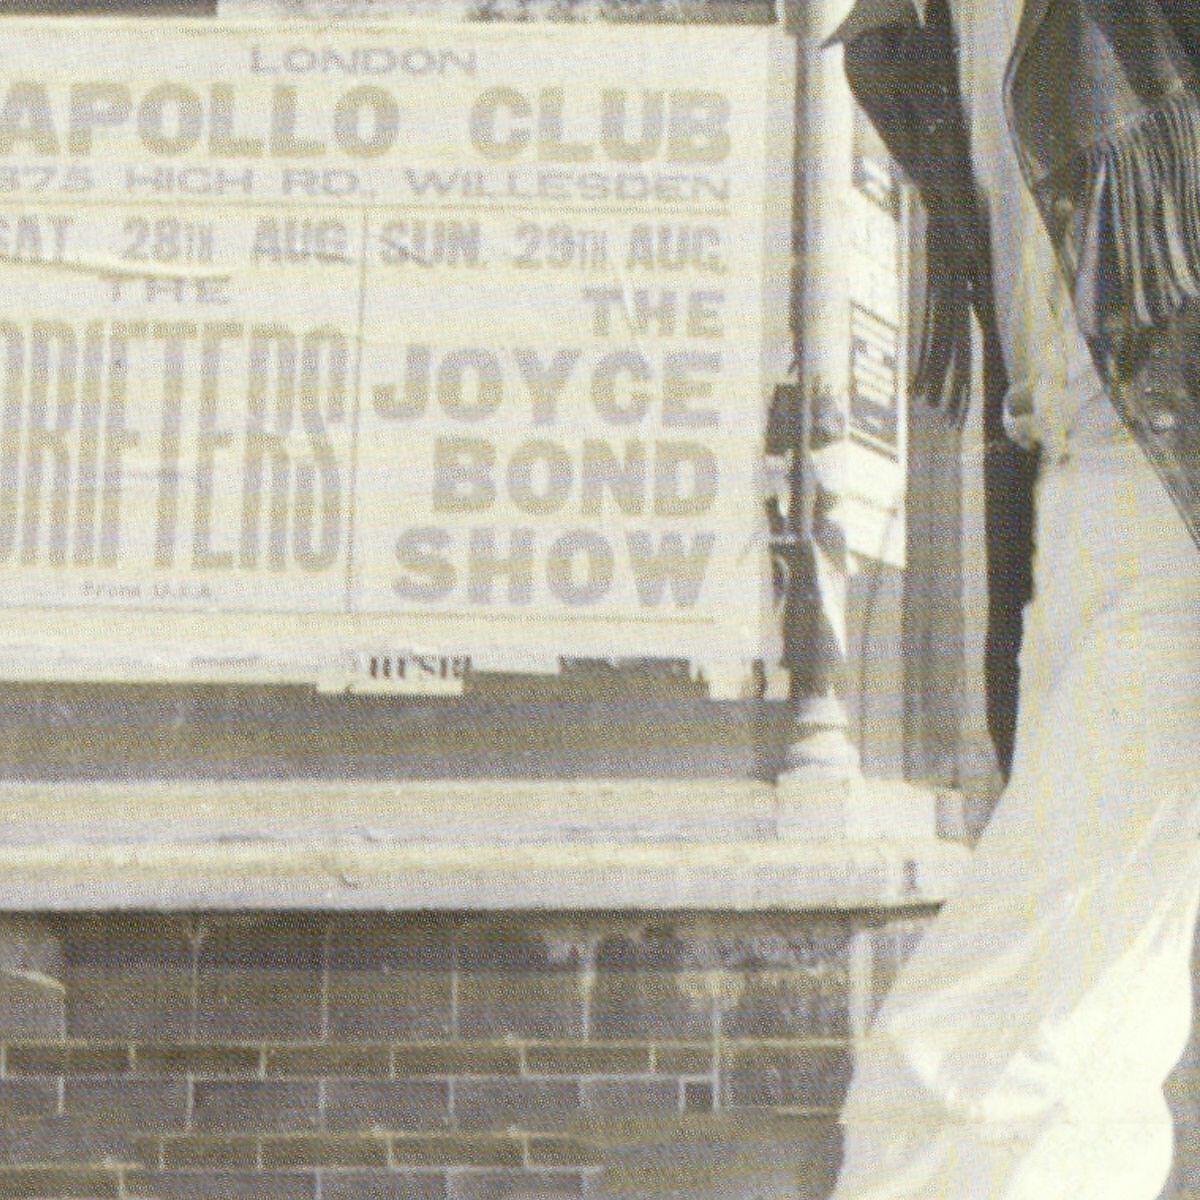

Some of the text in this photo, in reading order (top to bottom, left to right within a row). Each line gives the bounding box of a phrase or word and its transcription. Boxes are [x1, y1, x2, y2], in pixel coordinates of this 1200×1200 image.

[250, 44, 477, 76] LONDON
[0, 80, 732, 165] APOLLO CLUB
[126, 167, 254, 196] HIGH
[404, 167, 731, 203] WILLESDEN
[99, 271, 232, 305] THE
[583, 286, 726, 340] THE
[371, 346, 725, 429] JOYCE
[432, 436, 718, 517] BOND
[392, 526, 716, 610] SHOW
